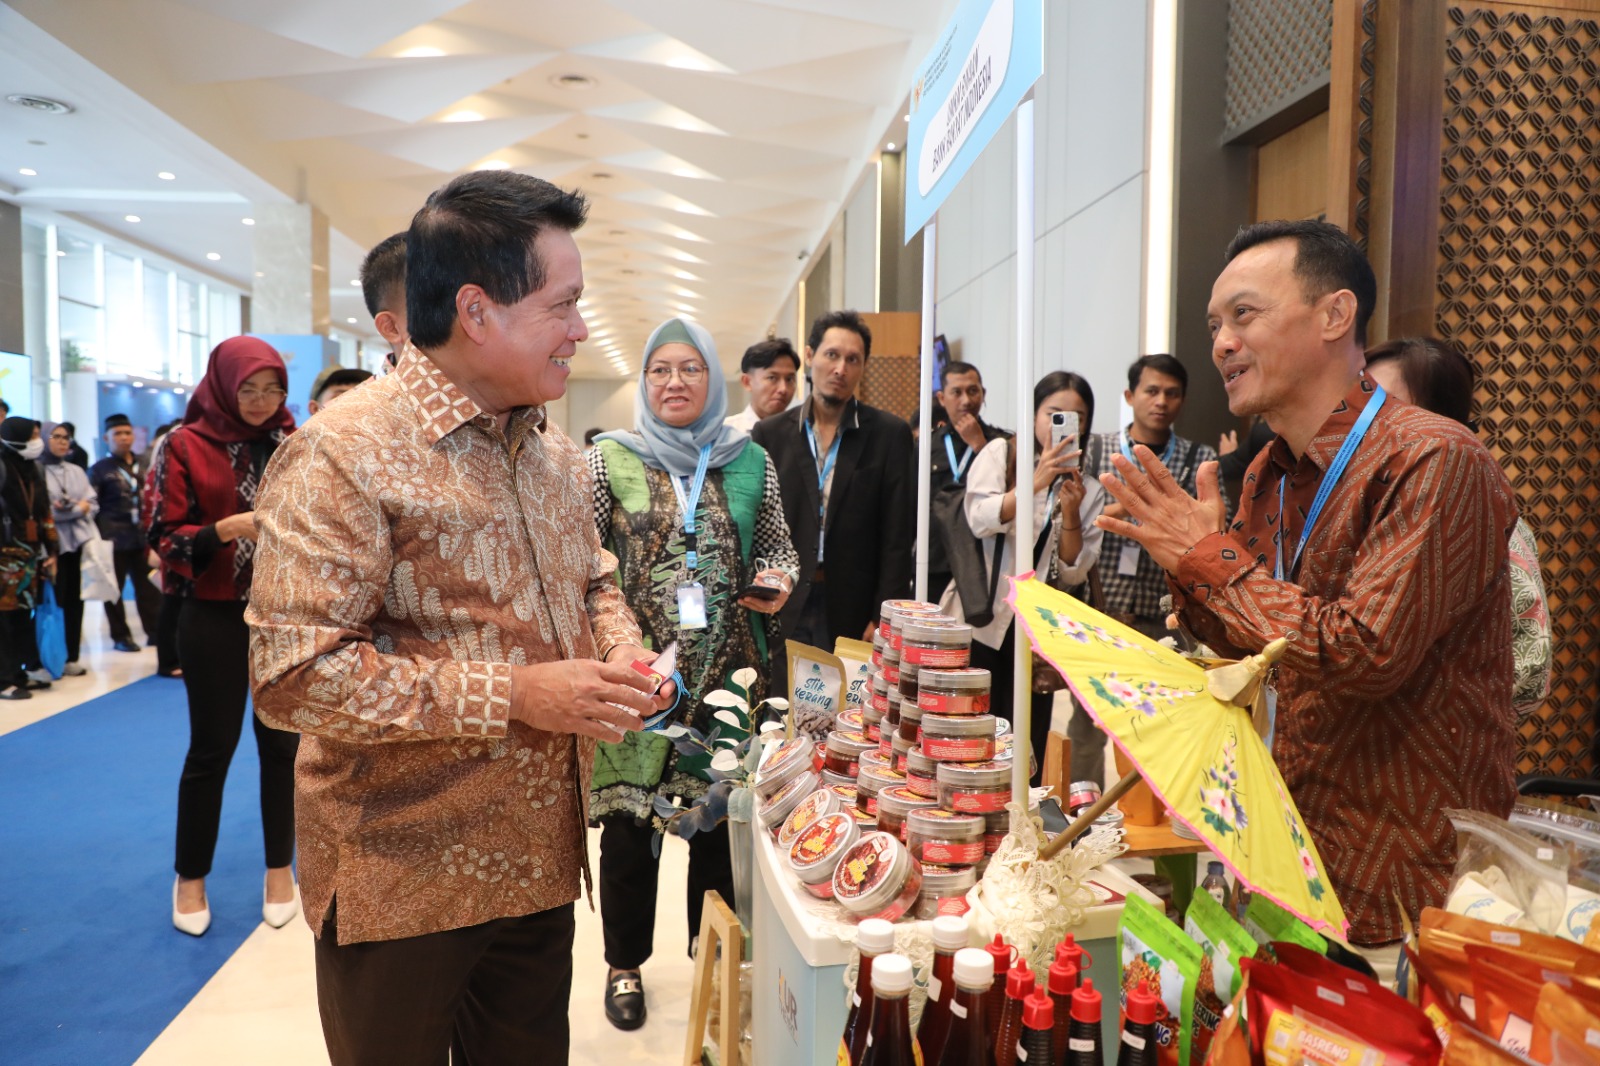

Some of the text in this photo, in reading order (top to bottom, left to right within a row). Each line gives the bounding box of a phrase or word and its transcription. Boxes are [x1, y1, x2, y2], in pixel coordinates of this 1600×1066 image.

[932, 54, 992, 174] BANK RAKYAT INDONESIA
